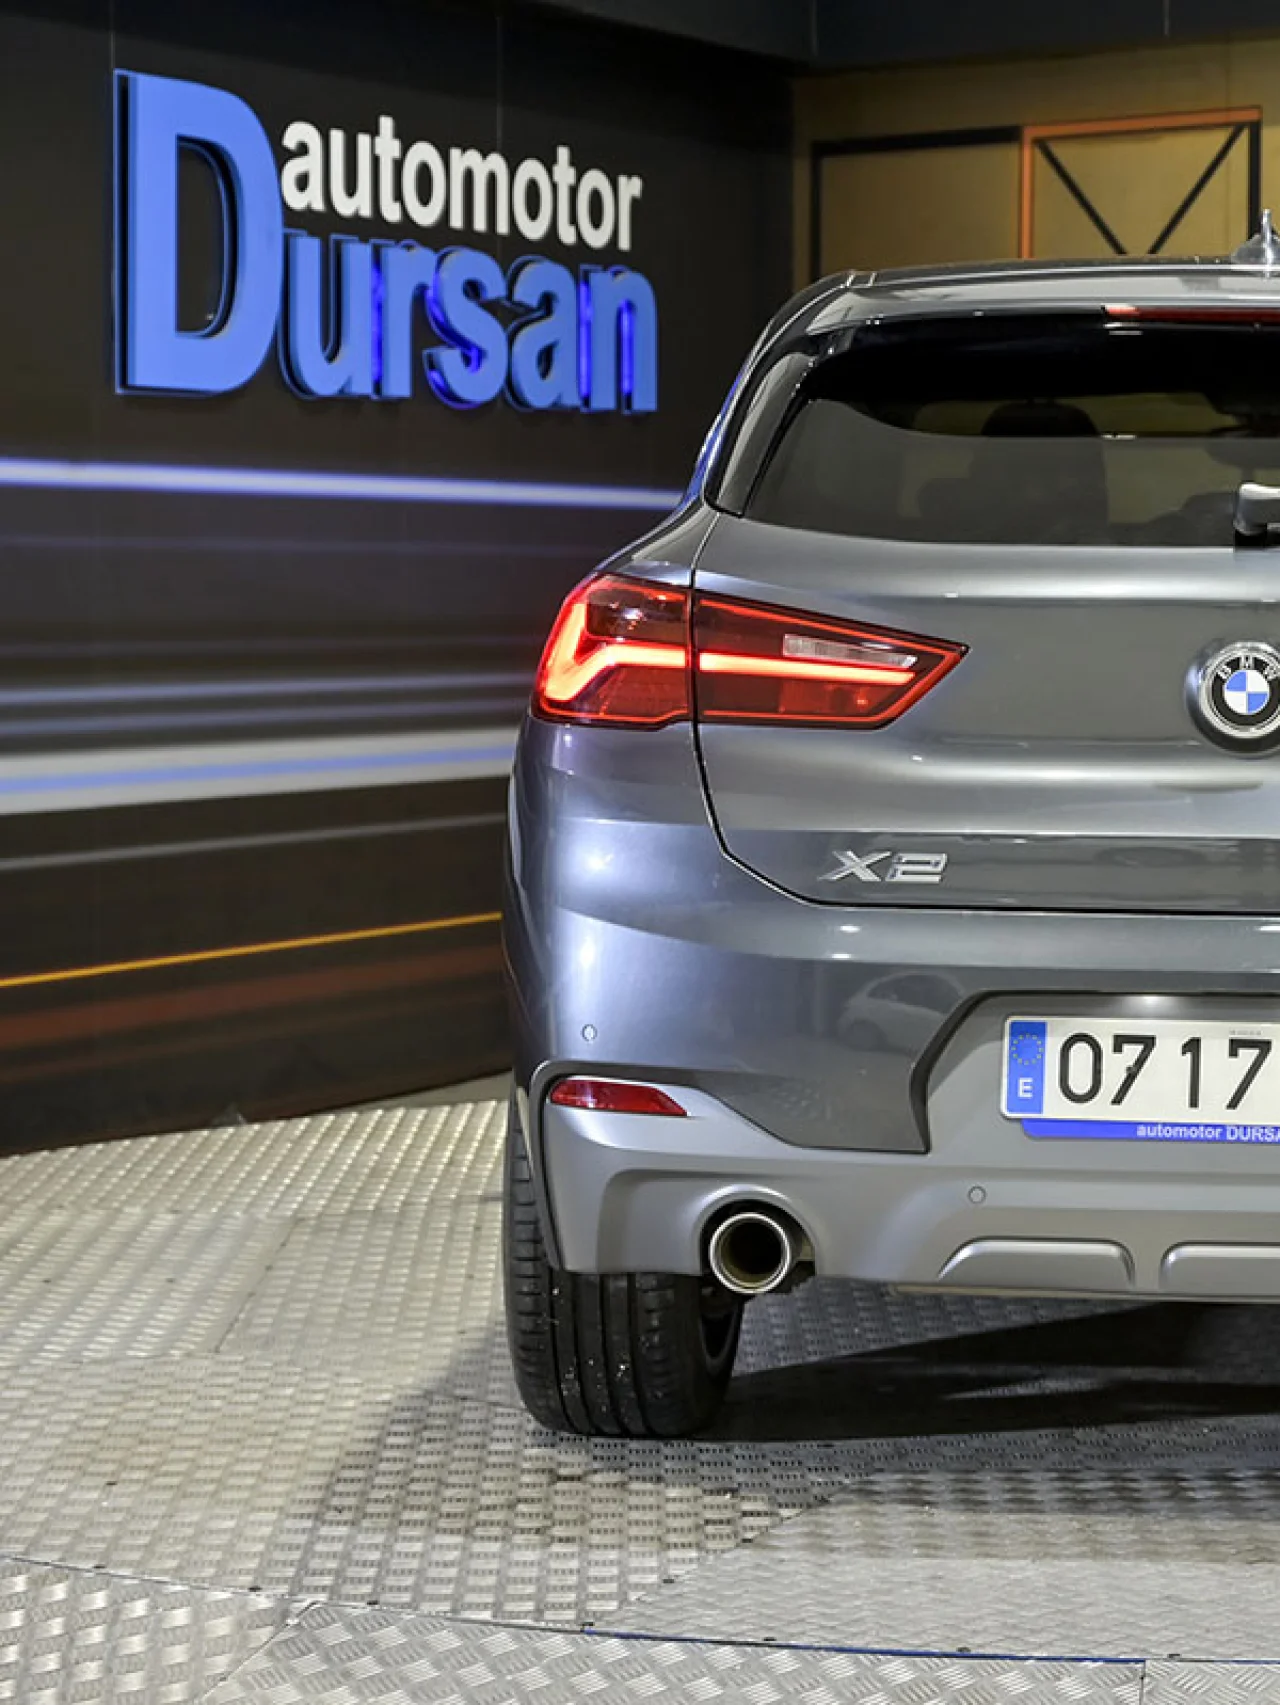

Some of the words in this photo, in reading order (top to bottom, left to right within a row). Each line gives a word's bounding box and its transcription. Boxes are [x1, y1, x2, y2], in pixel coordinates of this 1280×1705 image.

[281, 115, 643, 252] automotor
[113, 68, 658, 413] Dursan
[817, 850, 947, 882] X2
[1016, 1077, 1034, 1100] E
[1058, 1032, 1273, 1110] 0717
[1136, 1122, 1223, 1139] automotor
